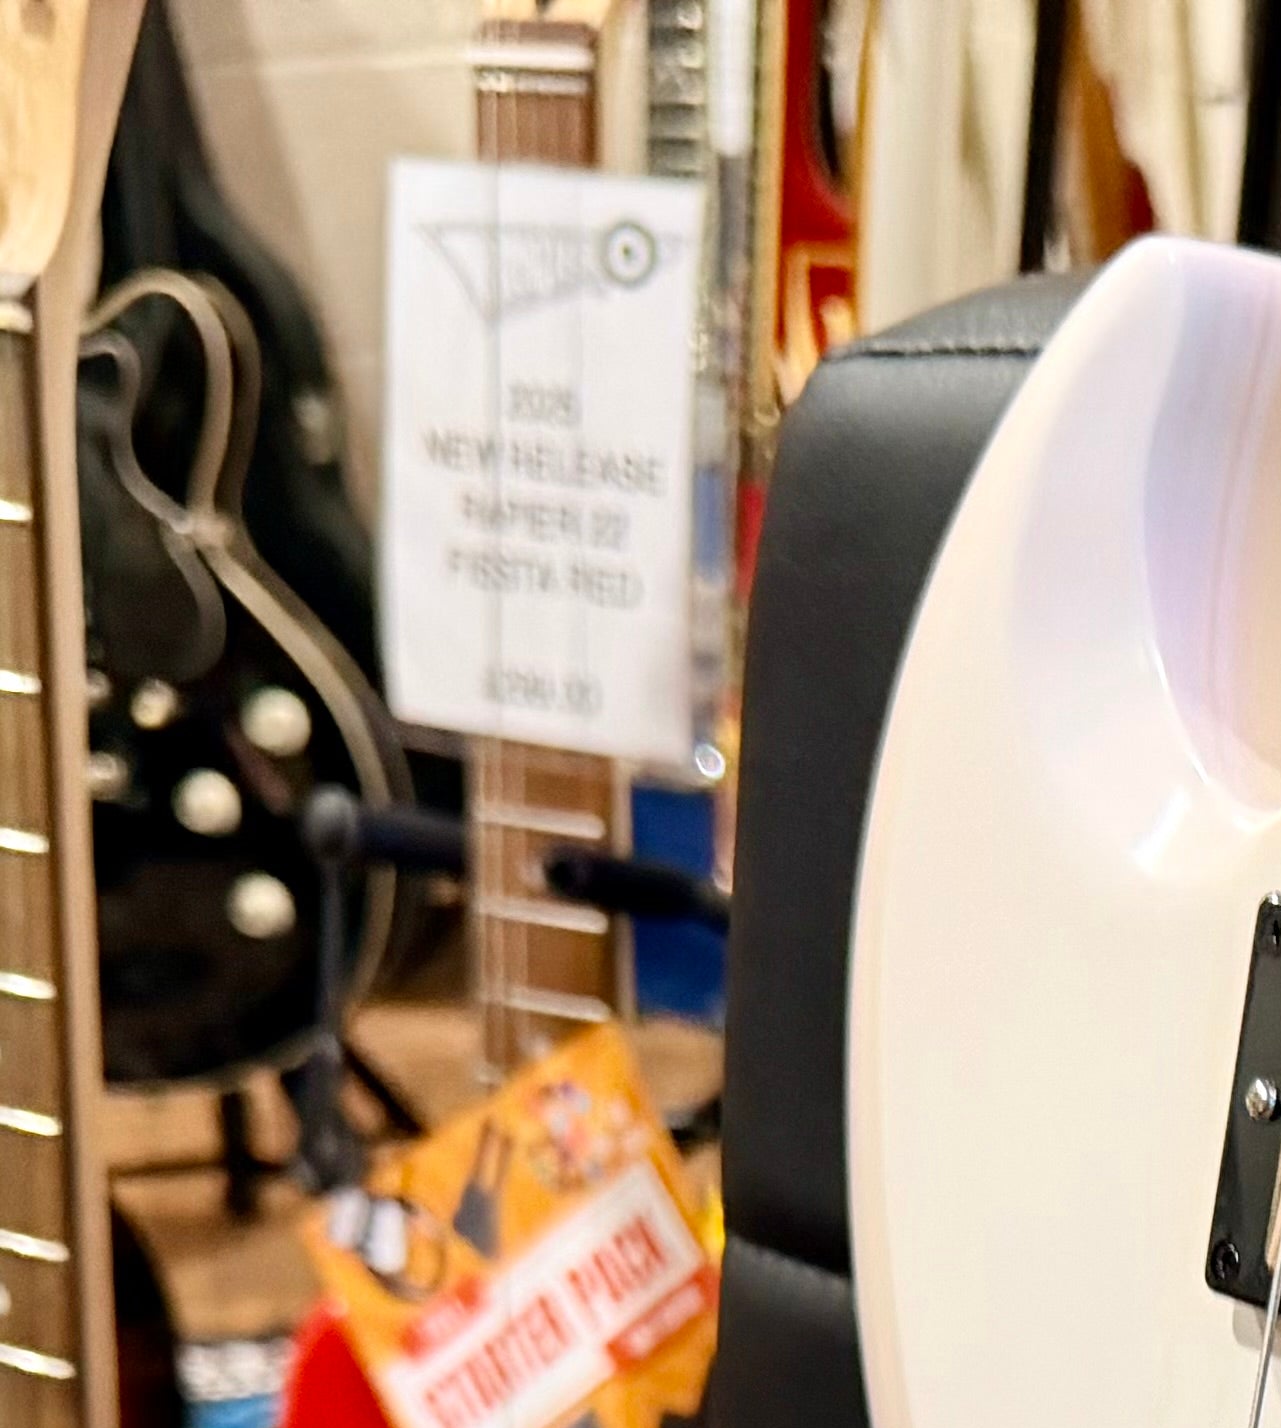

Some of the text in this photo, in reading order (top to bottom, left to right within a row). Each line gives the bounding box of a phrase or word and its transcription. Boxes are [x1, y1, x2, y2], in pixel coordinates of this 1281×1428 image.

[423, 428, 667, 498] NEW RELEASE
[566, 1217, 668, 1332] PACK
